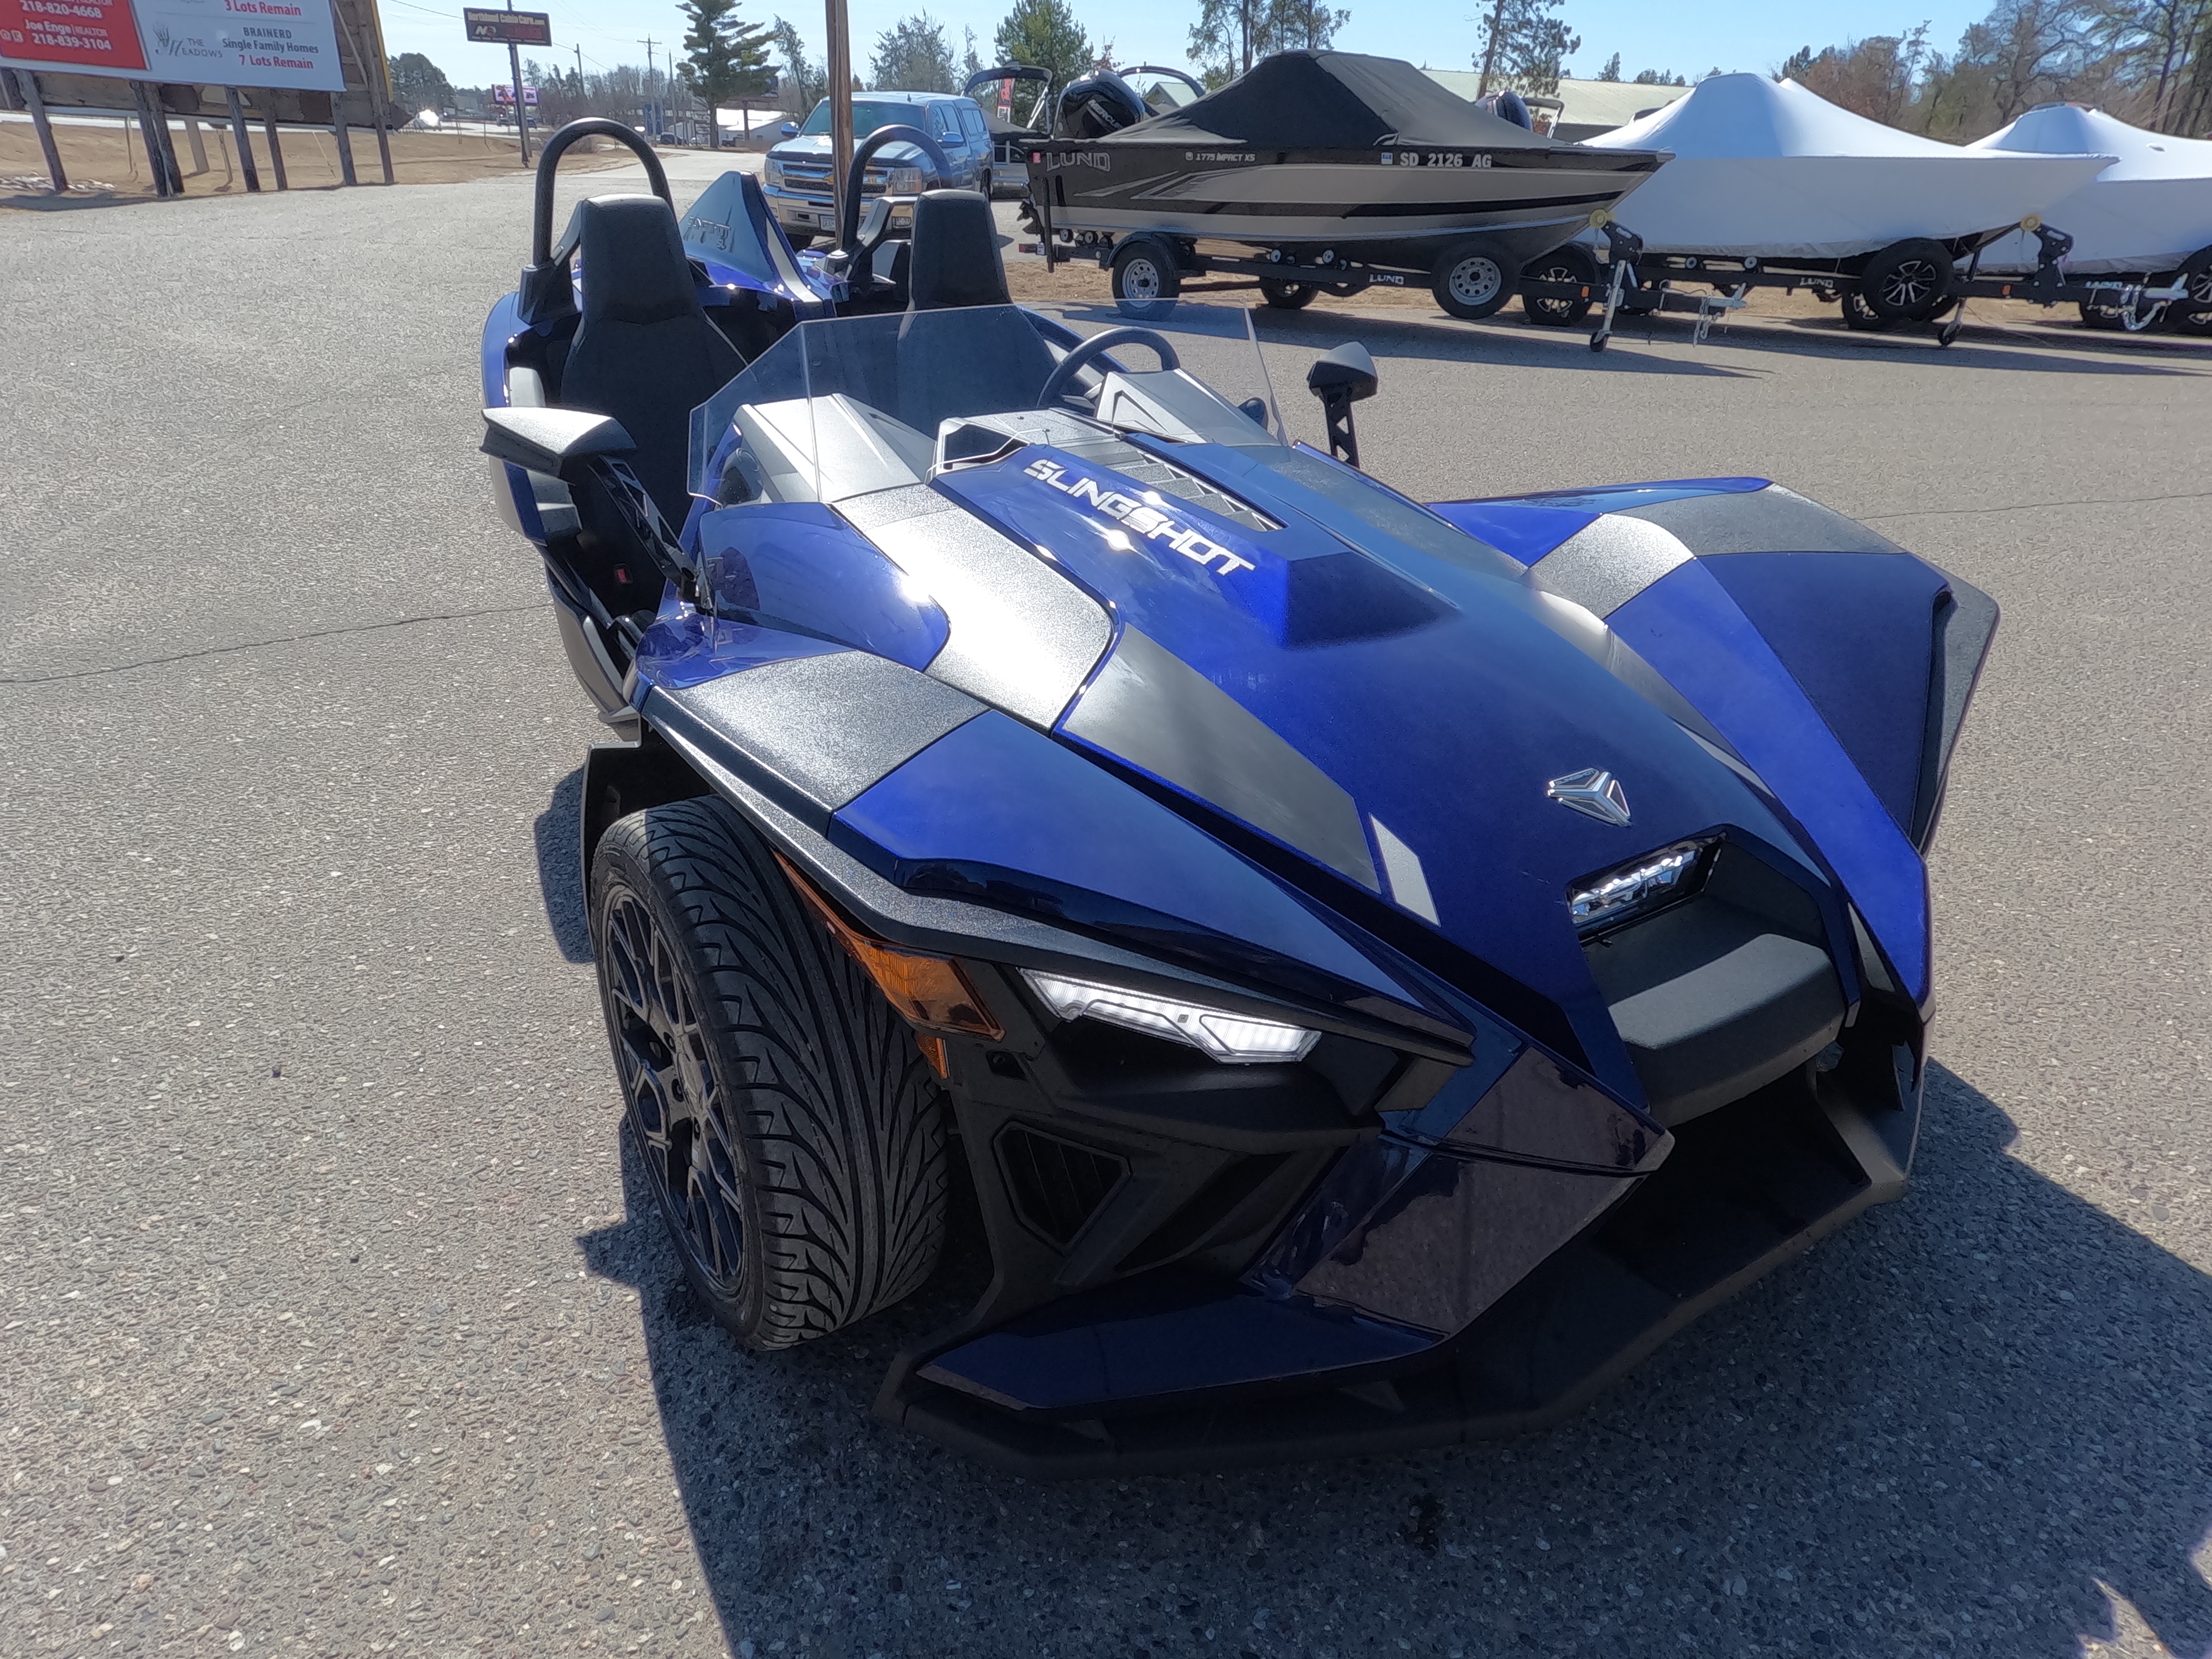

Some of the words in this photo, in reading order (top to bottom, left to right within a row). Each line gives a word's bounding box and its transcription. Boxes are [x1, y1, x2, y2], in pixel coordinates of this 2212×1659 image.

[22, 0, 103, 18] 218-820-4668
[224, 0, 232, 11] 3
[234, 0, 257, 13] Lots
[259, 2, 301, 15] Remain
[25, 19, 44, 30] Joe
[43, 20, 71, 35] Enge
[243, 27, 292, 39] BRAINERD
[32, 33, 112, 50] 218-839-3104
[187, 38, 205, 46] THE
[223, 39, 252, 51] Single
[253, 40, 284, 54] Family
[286, 42, 319, 53] Homes
[238, 54, 245, 65] 7
[249, 55, 272, 66] Lots
[273, 56, 314, 69] Remain
[1046, 152, 1110, 171] LUND
[1217, 152, 1243, 161] IMPACT
[1400, 153, 1419, 166] SD
[1427, 153, 1463, 168] 2126
[1472, 154, 1493, 168] AG
[1369, 274, 1404, 285] LUND
[1799, 277, 1834, 288] LUND
[1022, 459, 1256, 576] SLINGSHOT
